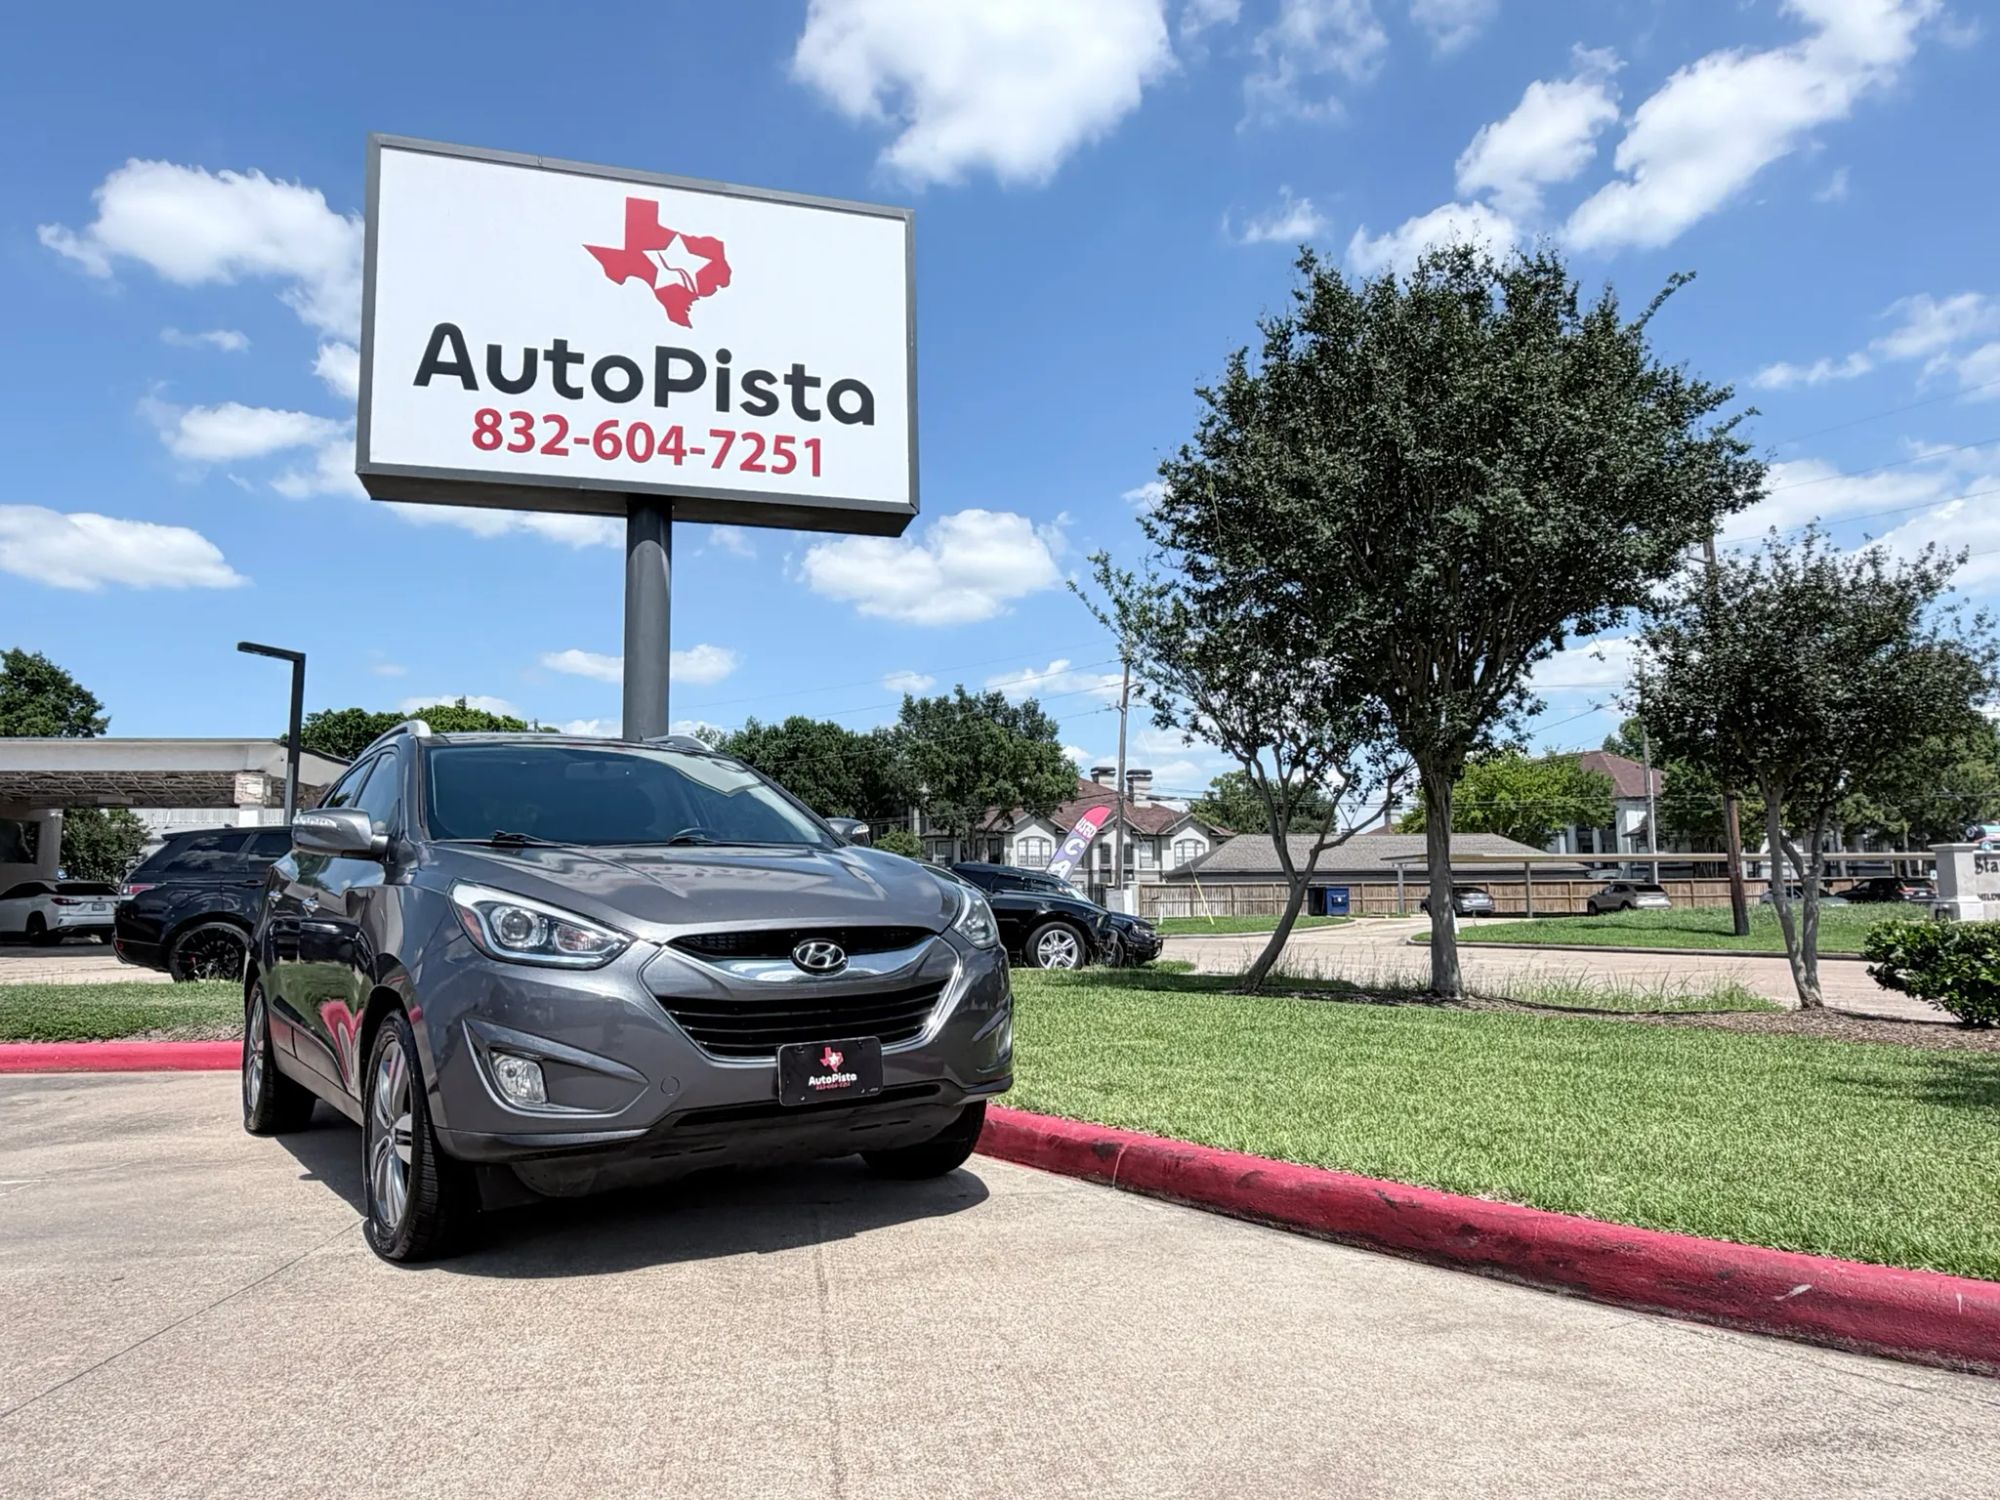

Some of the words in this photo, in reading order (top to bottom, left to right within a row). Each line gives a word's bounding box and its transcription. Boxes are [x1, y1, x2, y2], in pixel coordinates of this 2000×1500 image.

[413, 322, 875, 426] AutoPista
[472, 407, 822, 477] 832-604-7251
[808, 1072, 857, 1086] AutoPista
